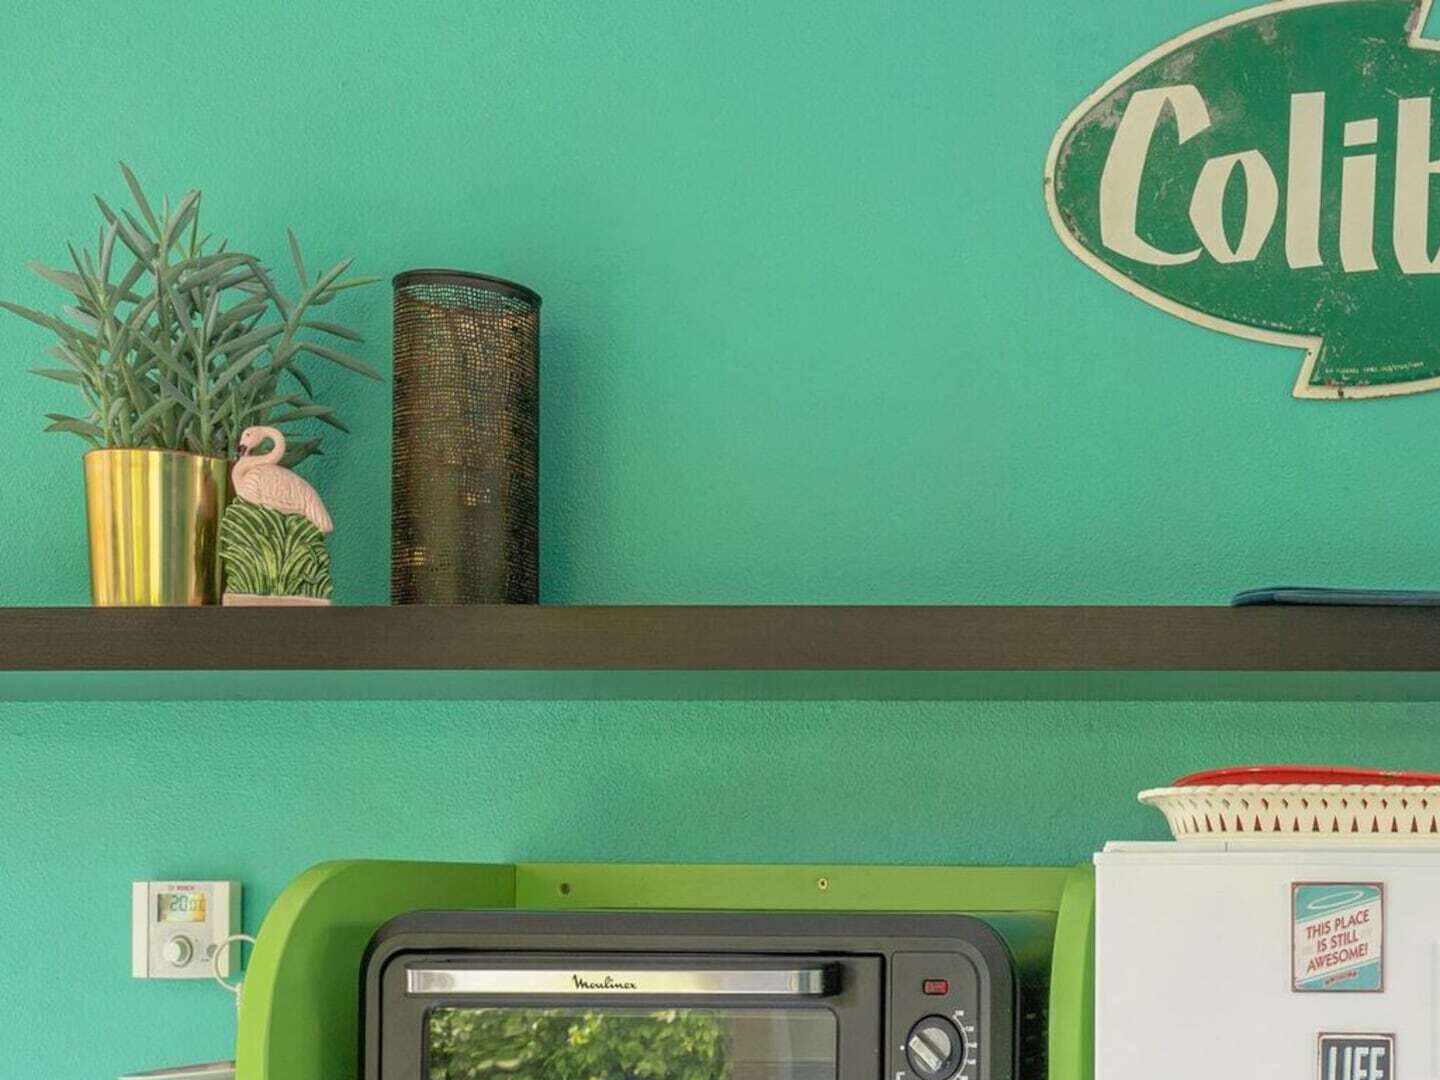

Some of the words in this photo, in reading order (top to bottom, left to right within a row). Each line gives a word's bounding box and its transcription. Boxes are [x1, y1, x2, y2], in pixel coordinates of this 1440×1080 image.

[1305, 920, 1331, 940] THIS
[1334, 909, 1370, 931] PLACE
[1316, 937, 1327, 954] IS
[1330, 929, 1359, 949] STILL
[1306, 942, 1368, 973] AWESOME!
[572, 973, 637, 990] Moulinex
